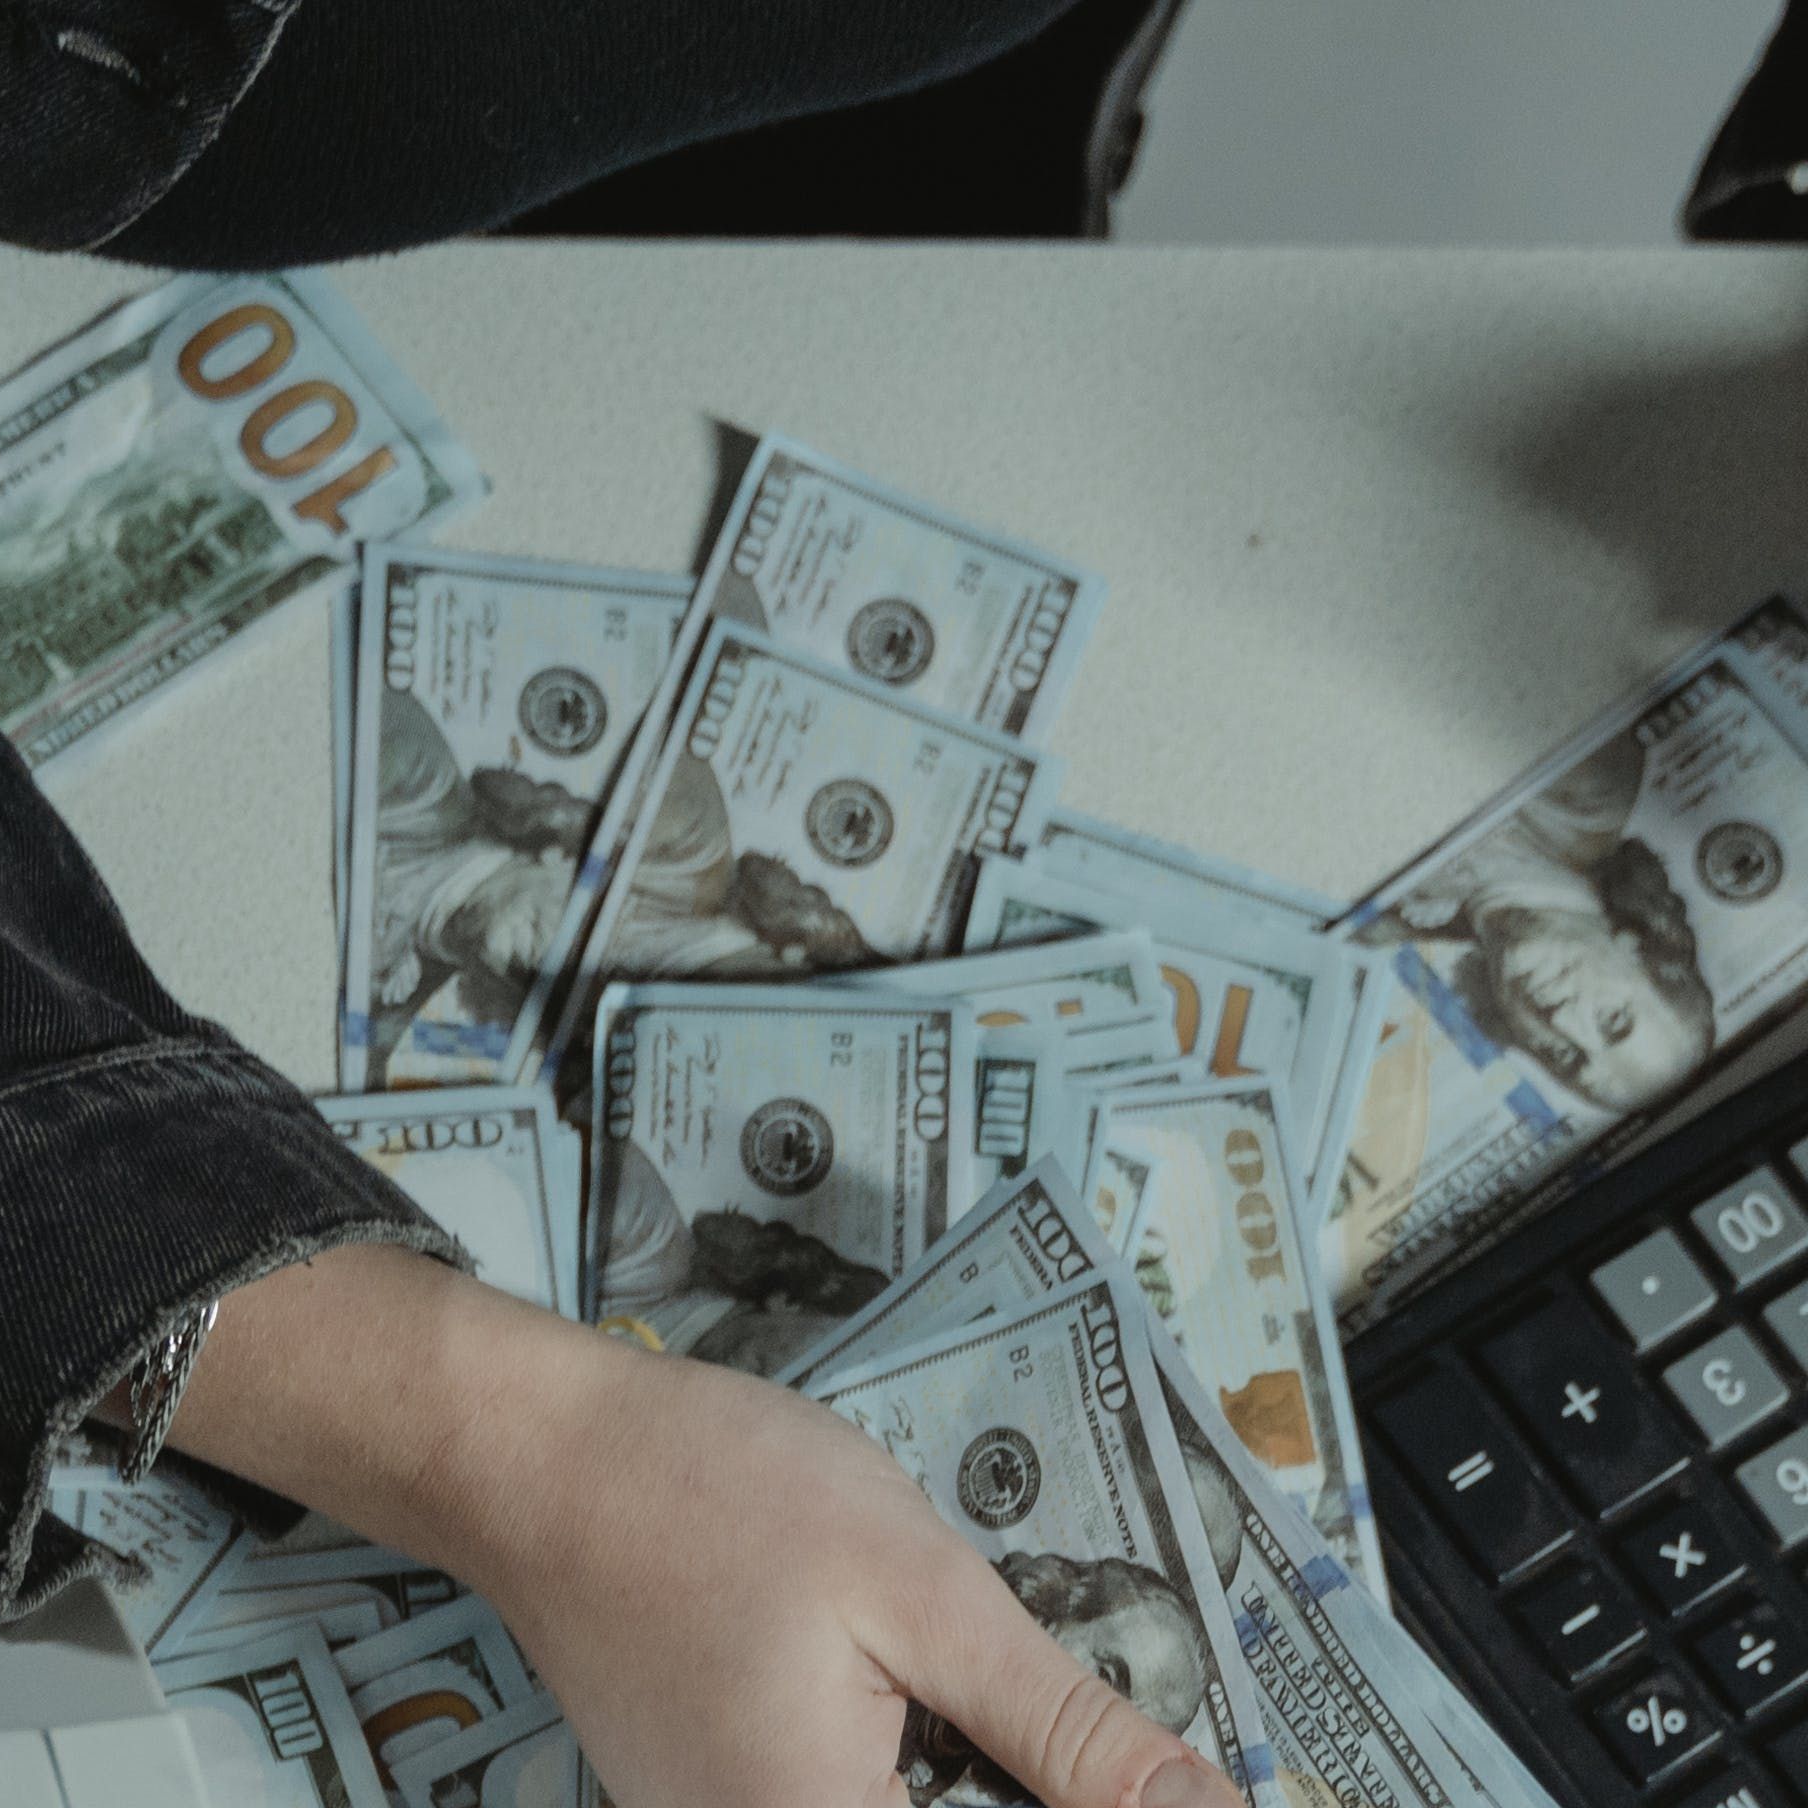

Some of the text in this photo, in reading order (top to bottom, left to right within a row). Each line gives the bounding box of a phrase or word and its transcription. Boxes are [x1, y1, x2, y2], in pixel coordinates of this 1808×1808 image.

[177, 304, 397, 536] 100
[1010, 585, 1071, 692] 100
[830, 1032, 852, 1067] B2
[914, 1022, 949, 1141] 100
[1225, 1130, 1287, 1287] 100
[1715, 1192, 1784, 1255] 00
[1010, 1344, 1033, 1383] B2
[1081, 1297, 1130, 1413] 100
[1703, 1359, 1745, 1410] 3
[1068, 1323, 1138, 1559] FEDERAL RESERVE NOTE
[251, 1669, 324, 1759] 100
